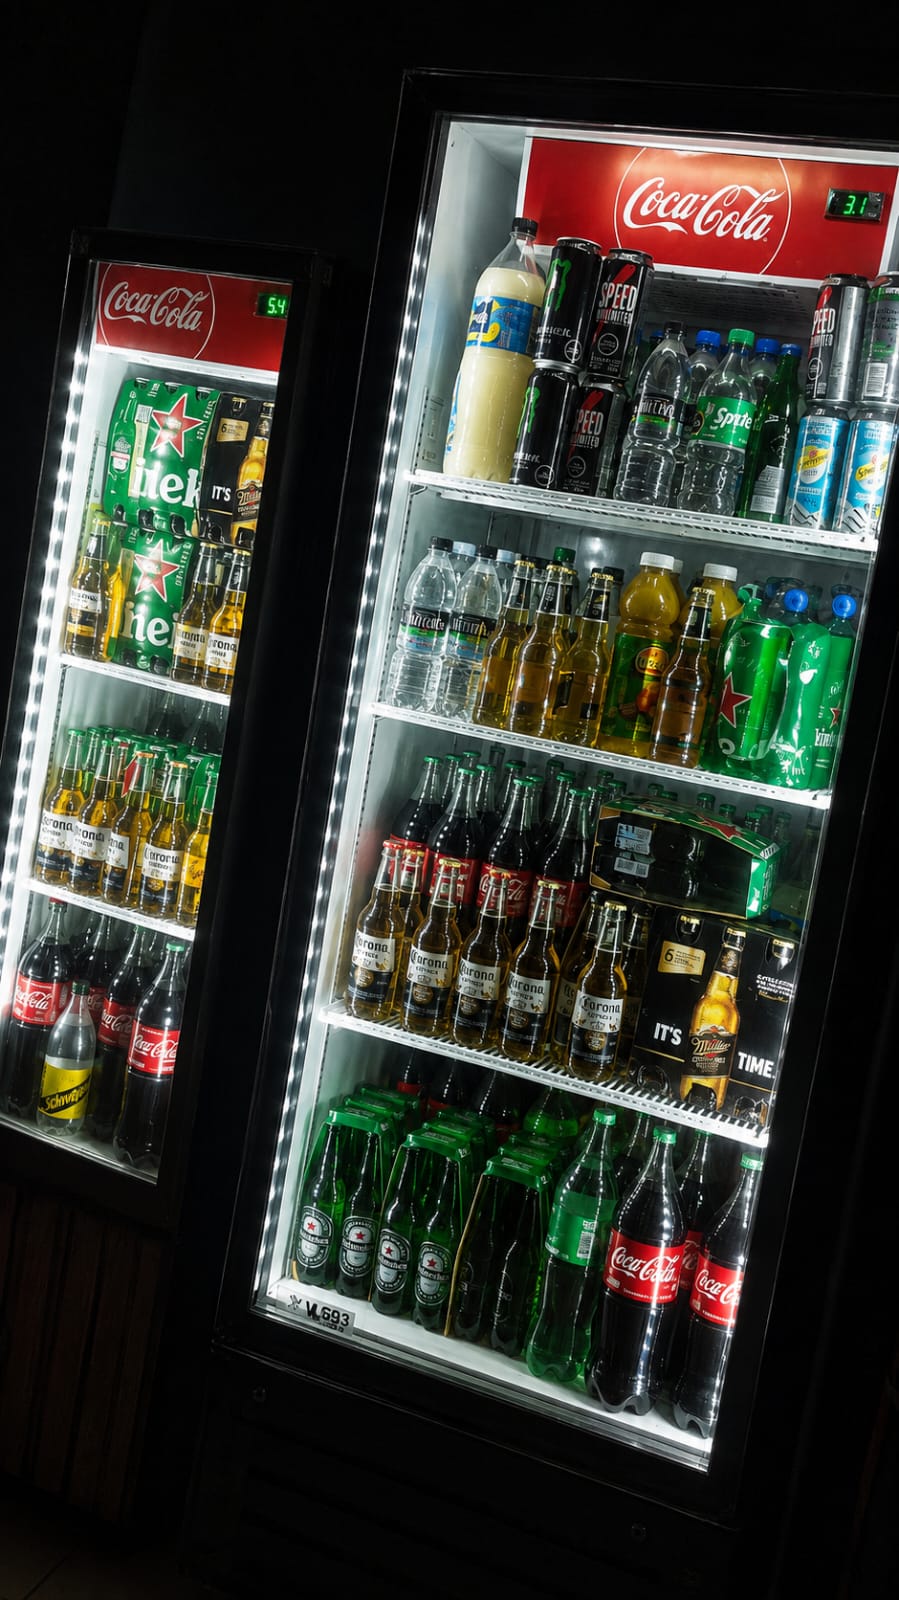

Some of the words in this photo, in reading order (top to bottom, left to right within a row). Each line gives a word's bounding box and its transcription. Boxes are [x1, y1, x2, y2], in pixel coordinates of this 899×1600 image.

[623, 177, 786, 242] Coca-Cola
[843, 195, 868, 215] 3.1
[104, 281, 209, 332] Coca-Cola
[268, 297, 286, 315] 5.4
[599, 282, 637, 312] SPEED
[811, 308, 836, 336] PEED
[714, 407, 753, 430] Sprite
[212, 485, 231, 502] IT'S
[410, 949, 449, 970] Corona
[665, 949, 674, 962] 6
[579, 996, 621, 1014] Corona
[654, 1022, 682, 1046] IT'S
[691, 1037, 731, 1056] Miller
[611, 1247, 680, 1283] Coca-Cola
